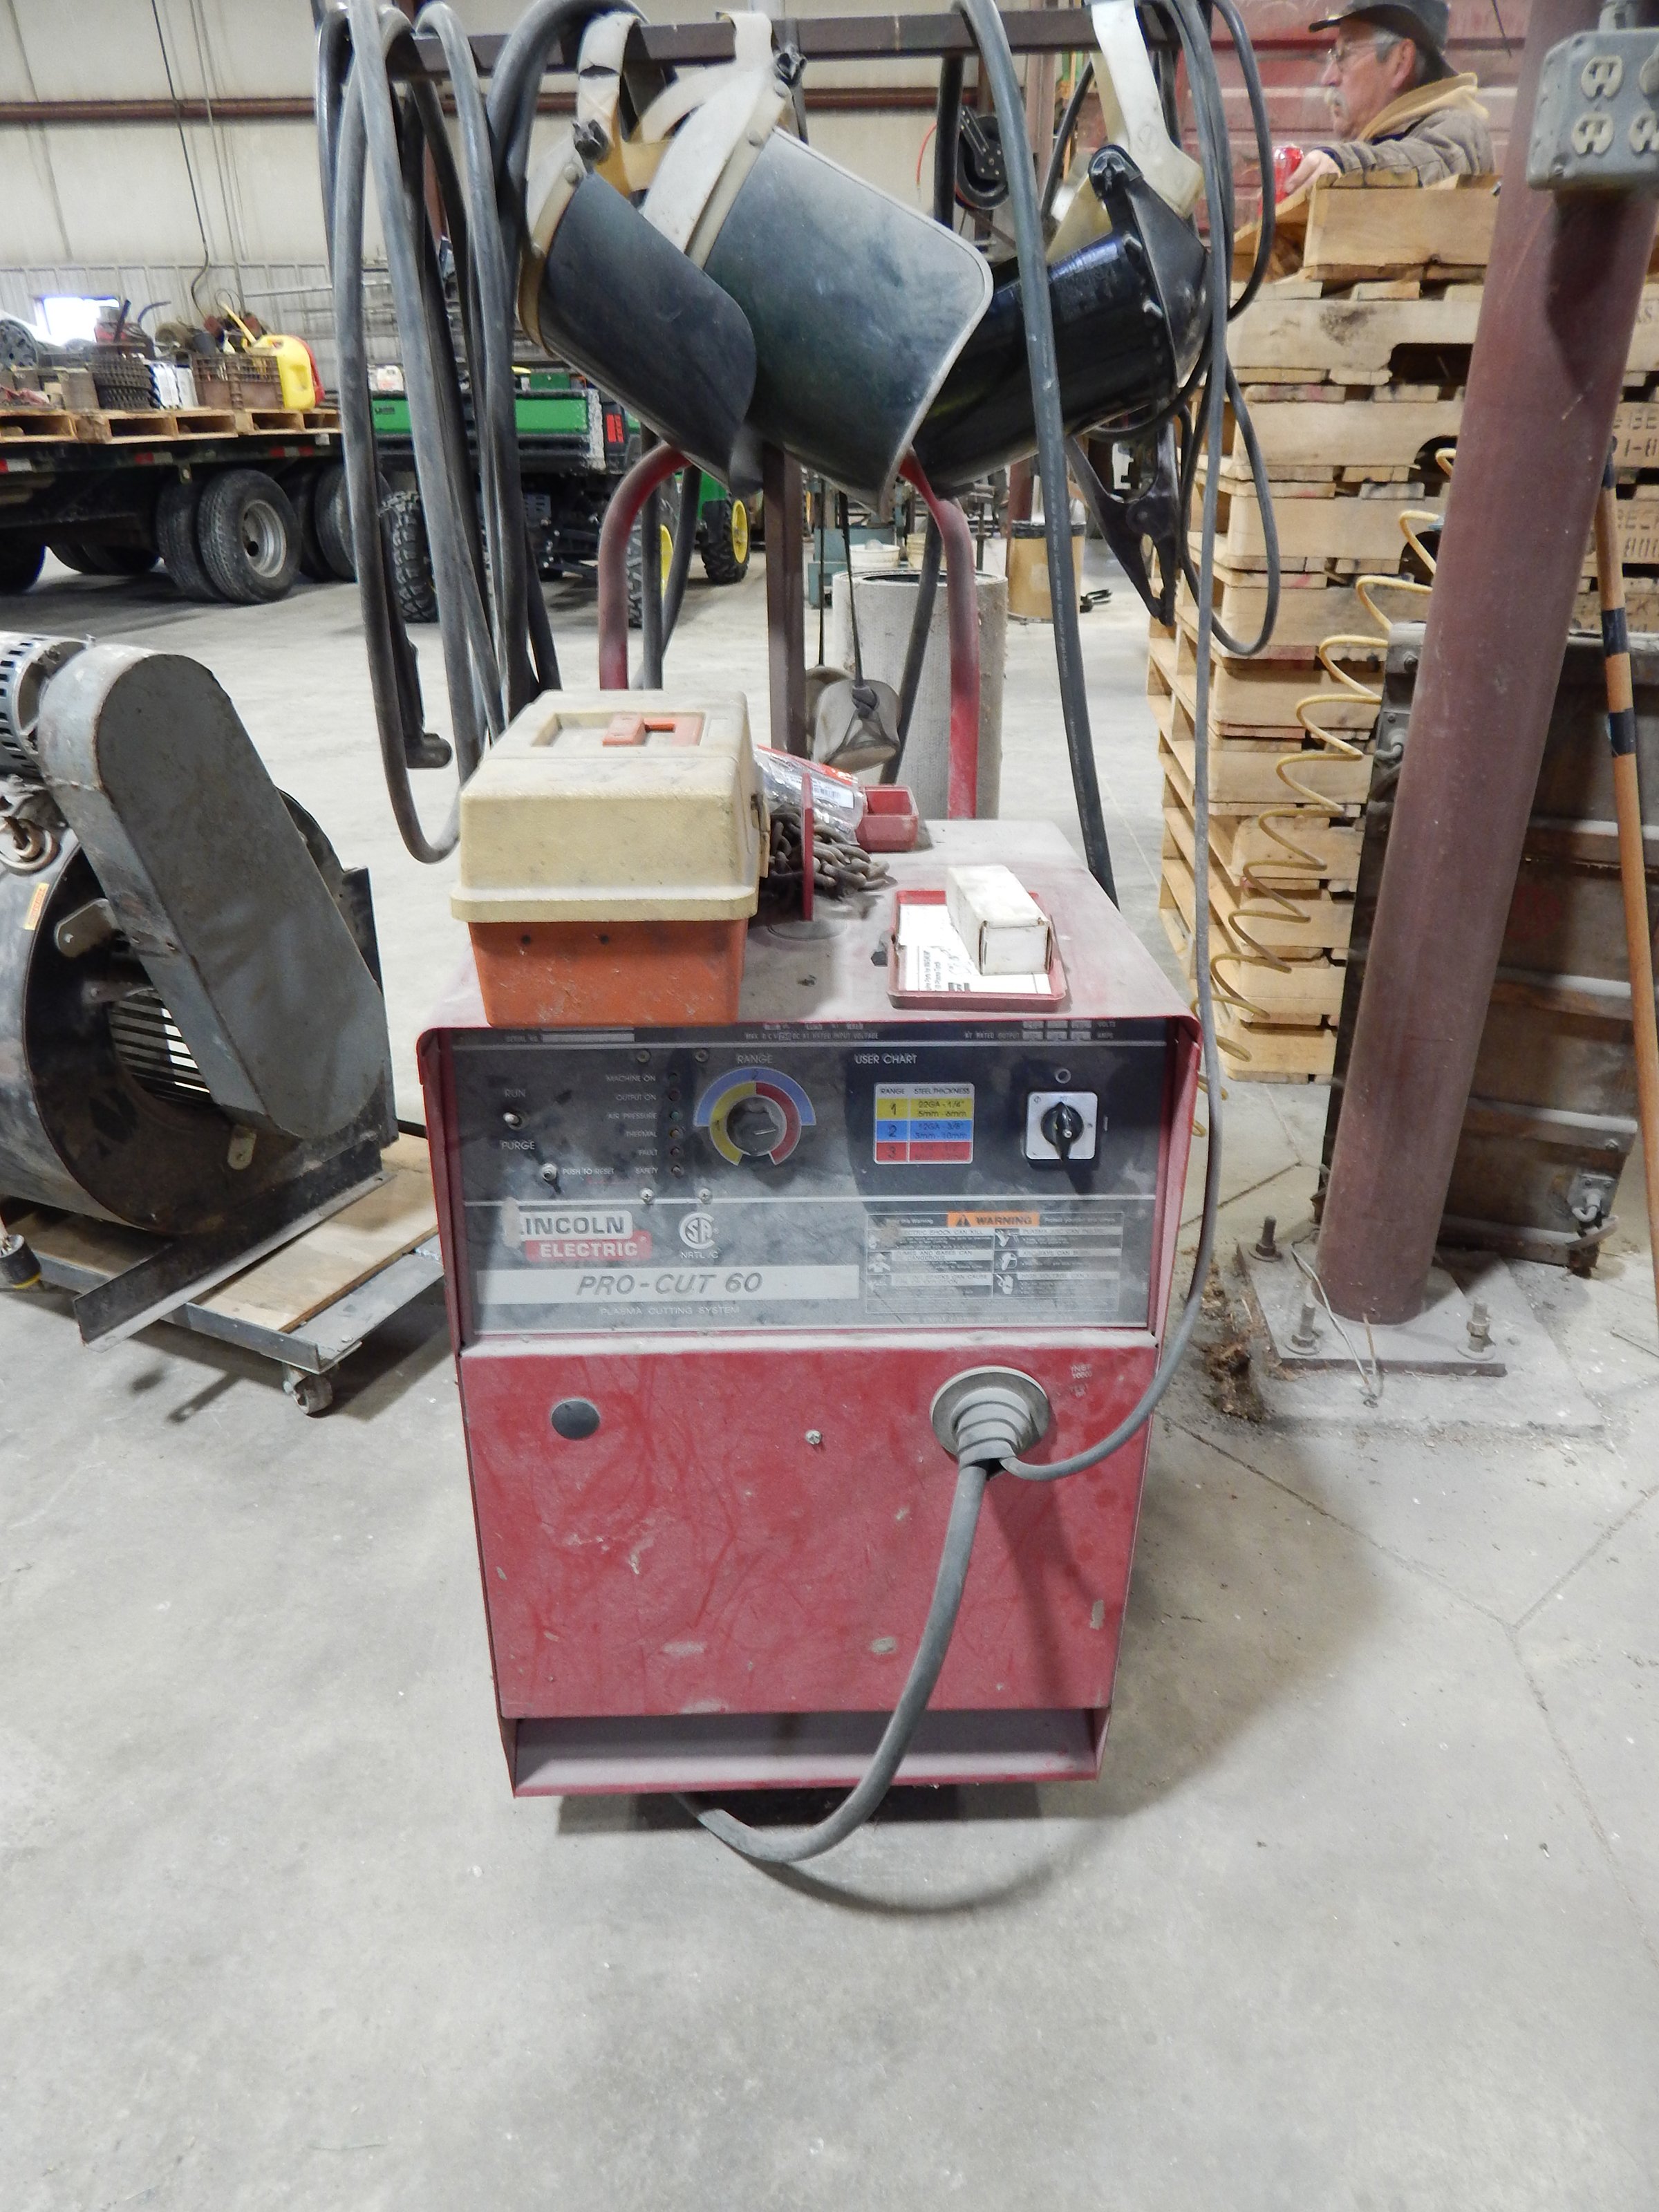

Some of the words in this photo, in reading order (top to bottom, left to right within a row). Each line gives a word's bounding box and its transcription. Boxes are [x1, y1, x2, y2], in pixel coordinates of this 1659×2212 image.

[736, 1054, 774, 1064] RANGE
[854, 1054, 879, 1065] USER
[883, 1053, 918, 1064] CHART
[504, 1089, 526, 1098] RUN
[890, 1103, 897, 1116] 1
[888, 1124, 897, 1138] 2
[501, 1141, 536, 1151] PURGE
[888, 1145, 897, 1159] 3
[518, 1217, 625, 1235] INCOLN
[976, 1216, 1033, 1226] WARNING
[539, 1241, 639, 1258] ELECTRIC
[576, 1273, 717, 1295] PRO-CUT
[724, 1272, 763, 1293] 60
[648, 1306, 693, 1315] CUTTING
[697, 1306, 740, 1314] SYSTEM
